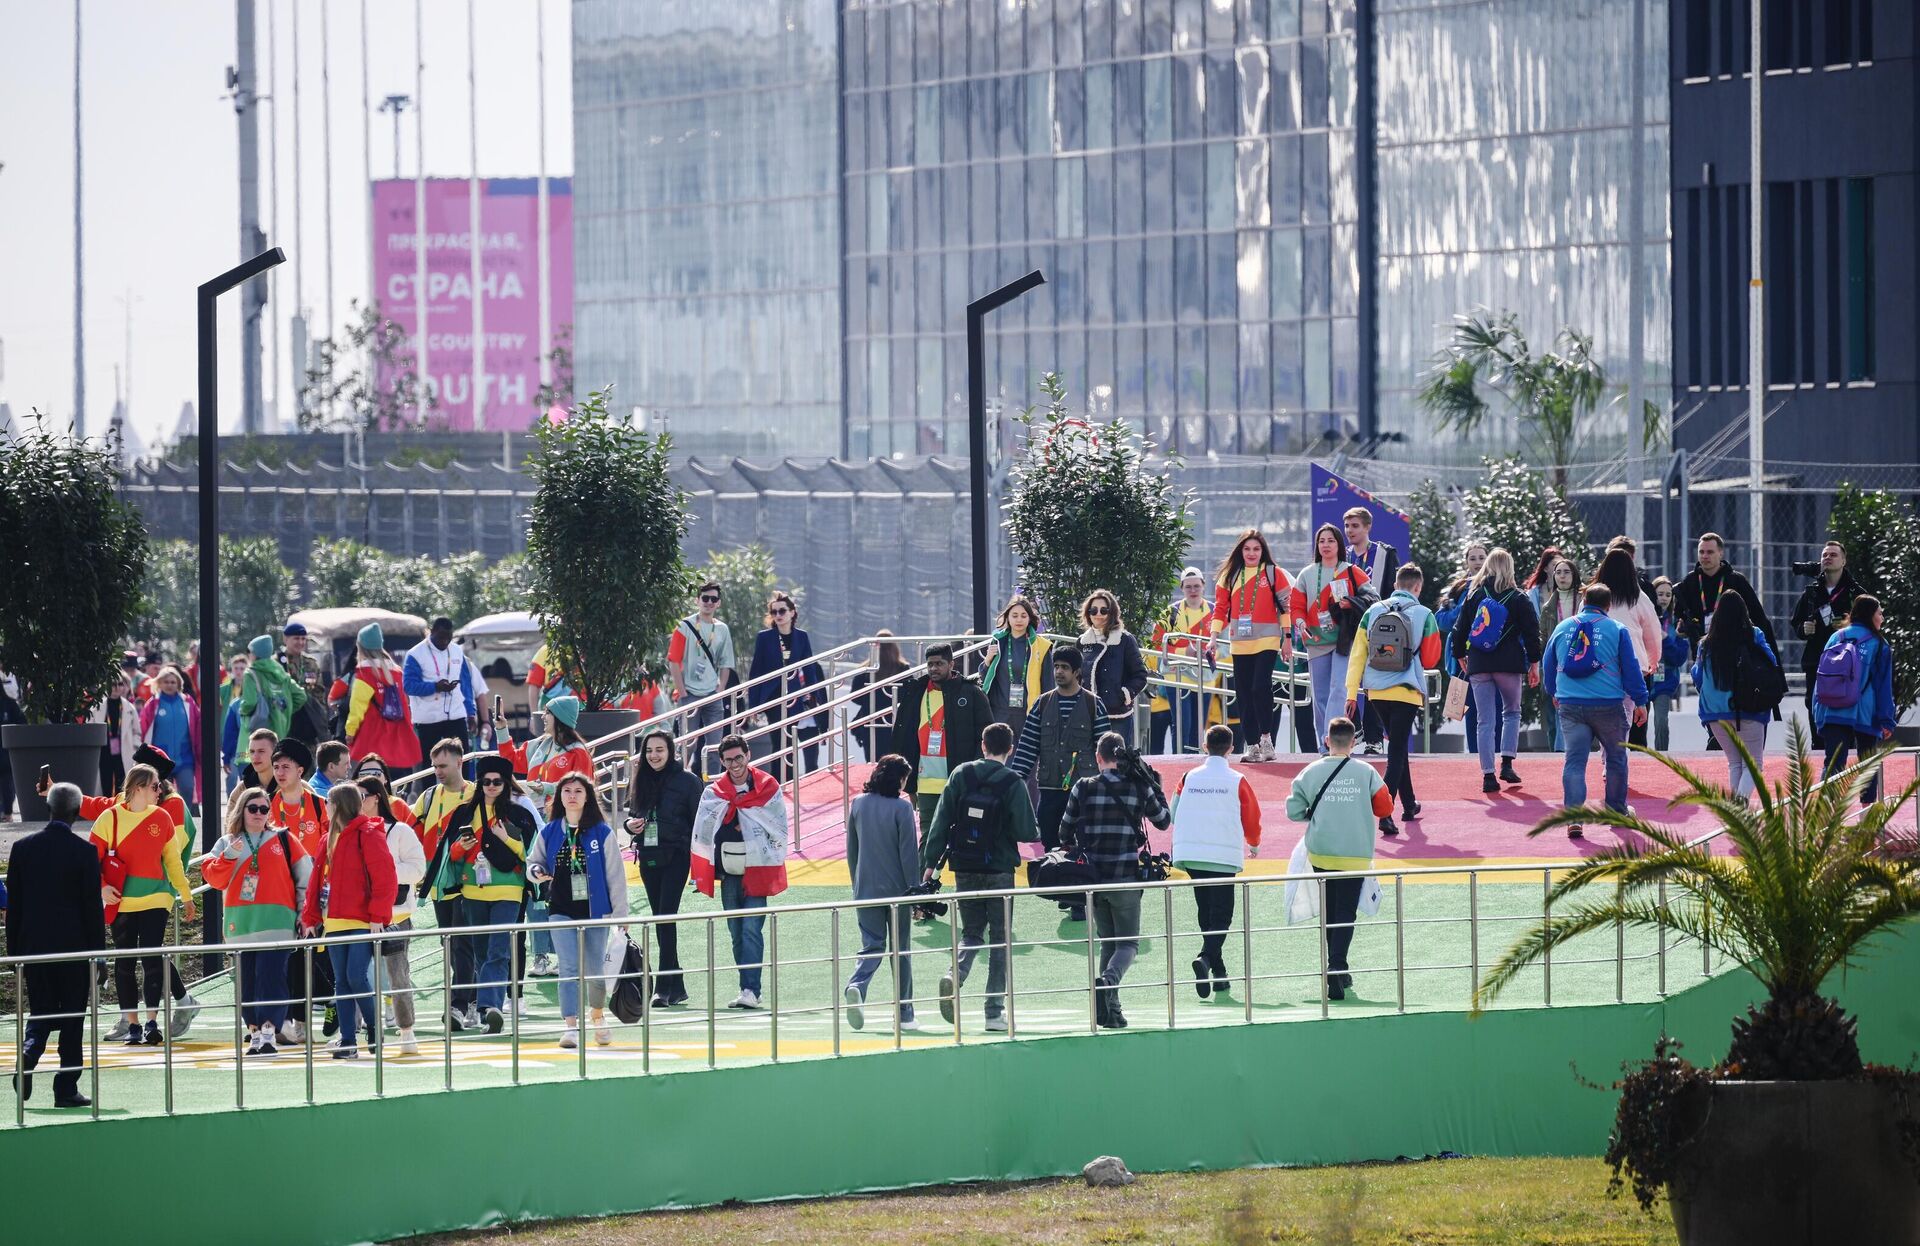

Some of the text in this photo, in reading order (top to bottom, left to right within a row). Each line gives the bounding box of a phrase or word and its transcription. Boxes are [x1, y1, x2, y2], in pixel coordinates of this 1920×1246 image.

[387, 272, 524, 300] СТРАНА
[428, 333, 527, 350] COUTRY
[391, 373, 527, 405] OUTH
